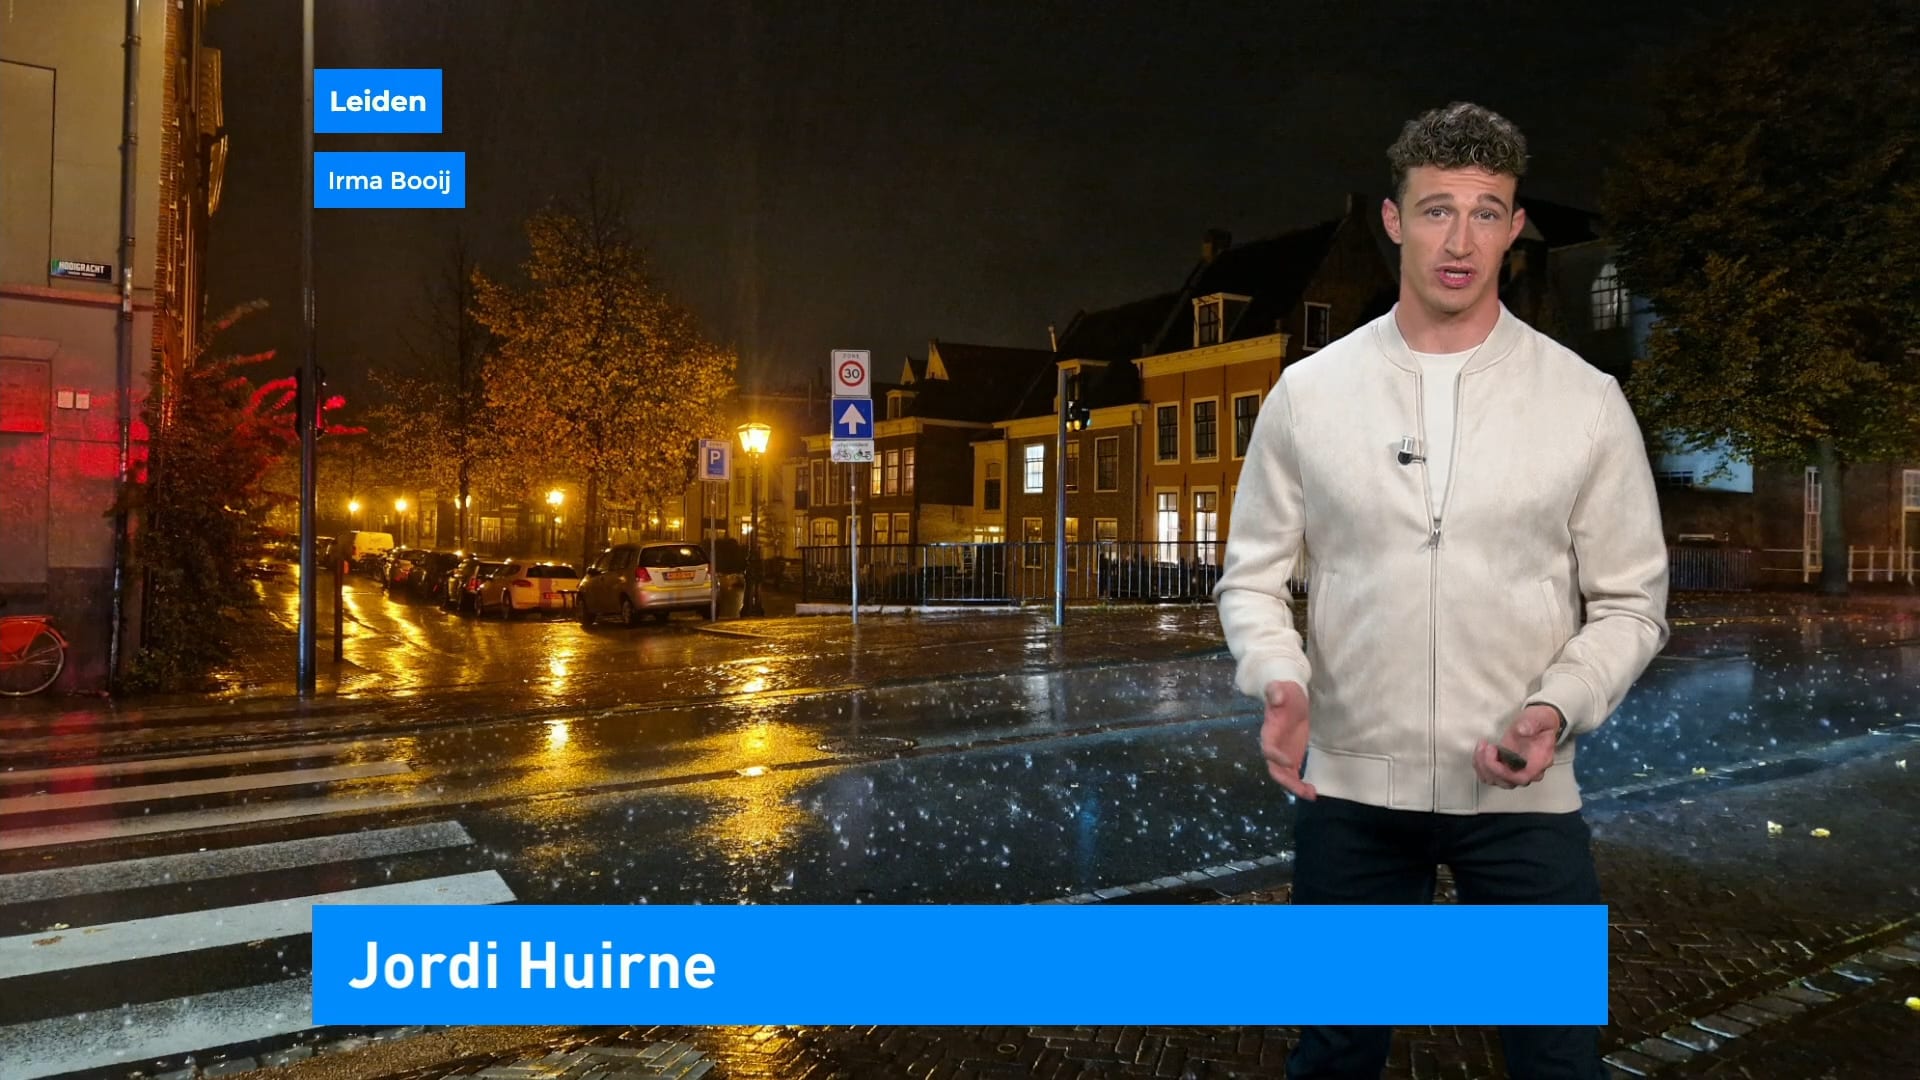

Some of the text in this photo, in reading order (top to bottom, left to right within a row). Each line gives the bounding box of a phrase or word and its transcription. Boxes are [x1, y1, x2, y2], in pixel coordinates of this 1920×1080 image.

[58, 261, 105, 274] HOOIGRACHT
[844, 368, 860, 379] 30
[710, 450, 721, 465] P
